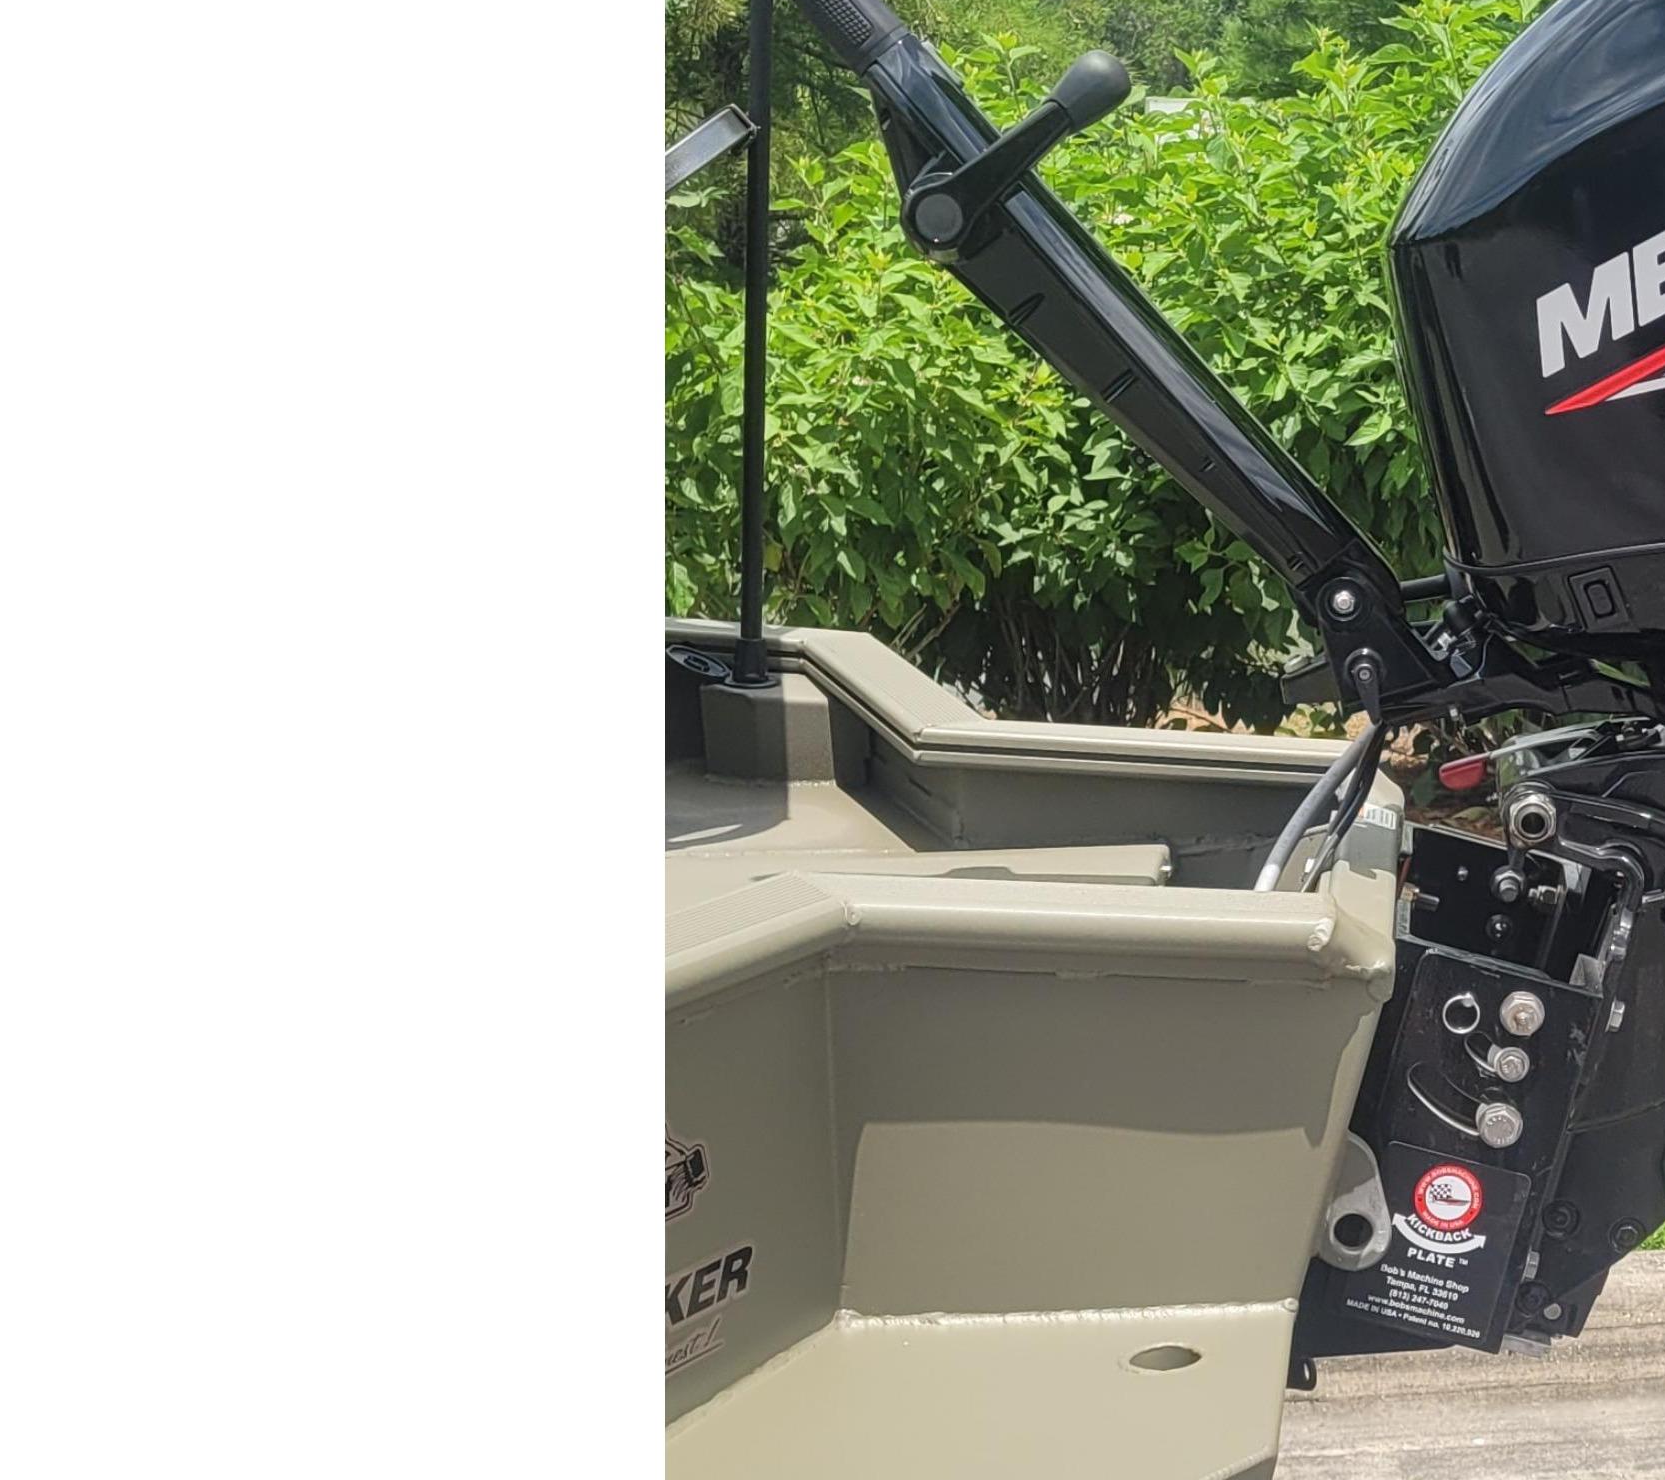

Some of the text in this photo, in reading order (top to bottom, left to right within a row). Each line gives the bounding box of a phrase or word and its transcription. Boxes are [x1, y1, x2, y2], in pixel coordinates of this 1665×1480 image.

[1406, 1213, 1472, 1242] KICKBACK
[1407, 1247, 1456, 1268] PLATE
[1380, 1263, 1470, 1294] Bob's Machine Shop
[1387, 1275, 1416, 1291] Tampa,
[1418, 1284, 1430, 1294] FL
[1346, 1298, 1370, 1310] MADE
[1380, 1307, 1397, 1317] USA
[1367, 1294, 1466, 1324] www.bobsmachine.com
